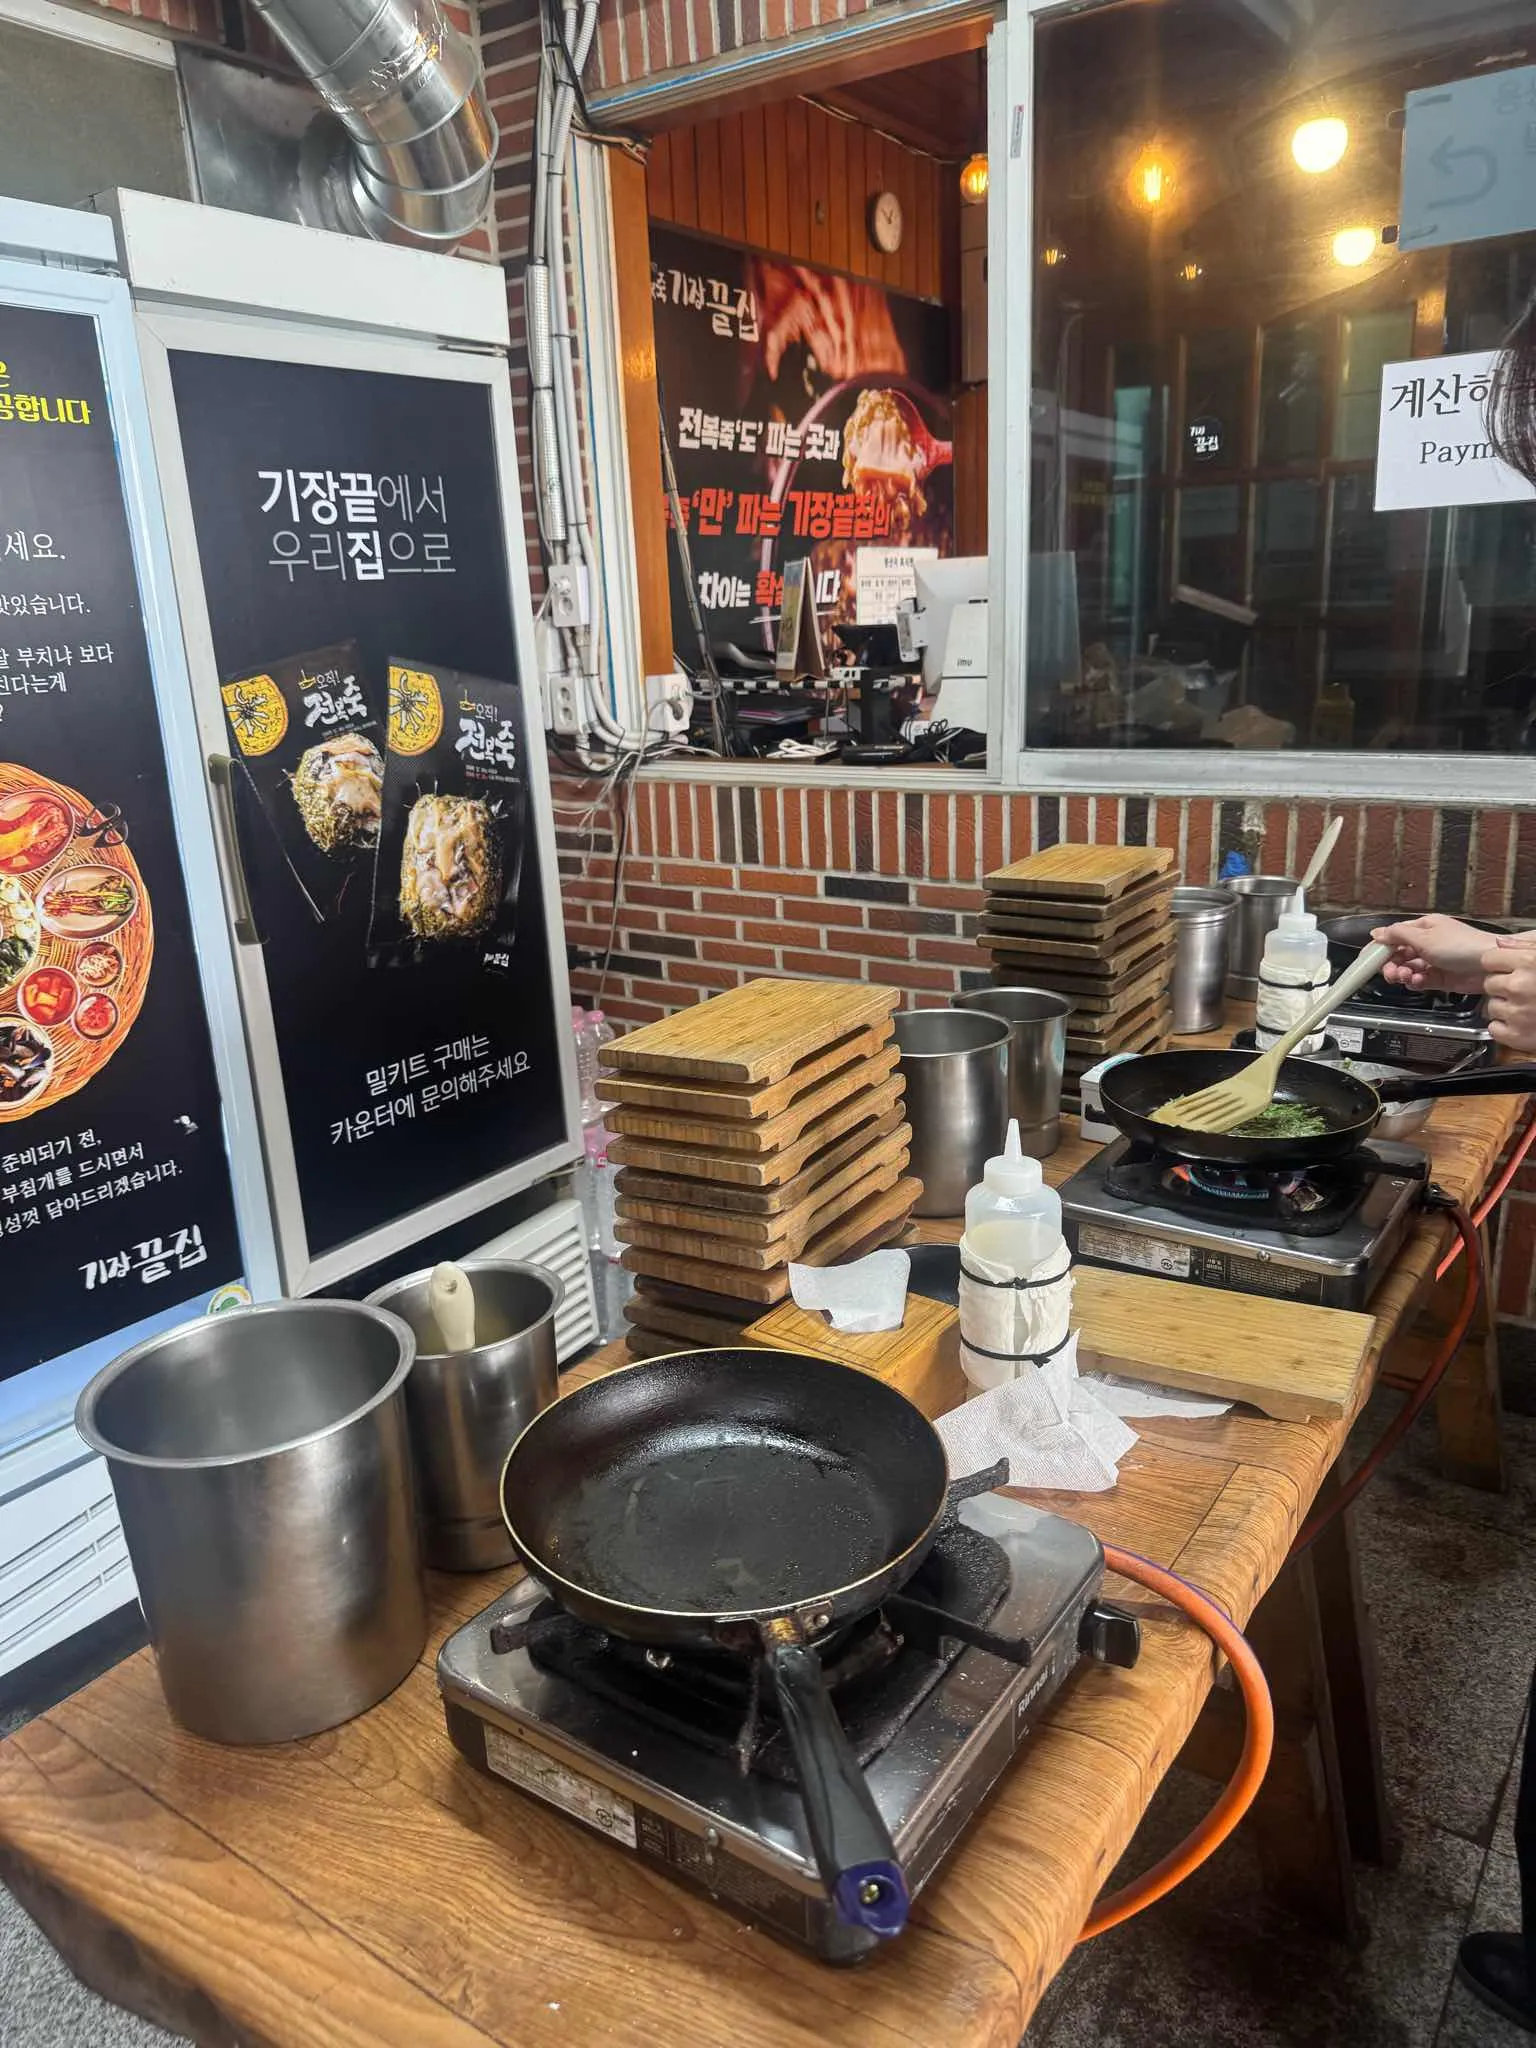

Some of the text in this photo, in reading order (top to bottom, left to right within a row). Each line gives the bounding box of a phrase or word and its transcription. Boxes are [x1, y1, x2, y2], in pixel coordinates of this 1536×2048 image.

[765, 421, 802, 457] 파는
[804, 422, 841, 461] 곳과
[257, 468, 448, 526] 기장끝에서
[735, 493, 783, 537] 파는
[789, 490, 893, 539] 기장끝집의
[268, 530, 457, 582] 우리집으로
[698, 571, 752, 610] 차이는
[17, 645, 73, 669] 부치냐
[79, 642, 114, 664] 보다
[366, 1033, 490, 1097] 밀키트 구매는
[330, 1050, 531, 1145] 카운터에 문의해주세요
[1, 1136, 73, 1175] 준비되기
[2, 1141, 146, 1205] 부침개를 드시면서
[0, 1158, 184, 1239] 성껏 담아드리겠습니다.
